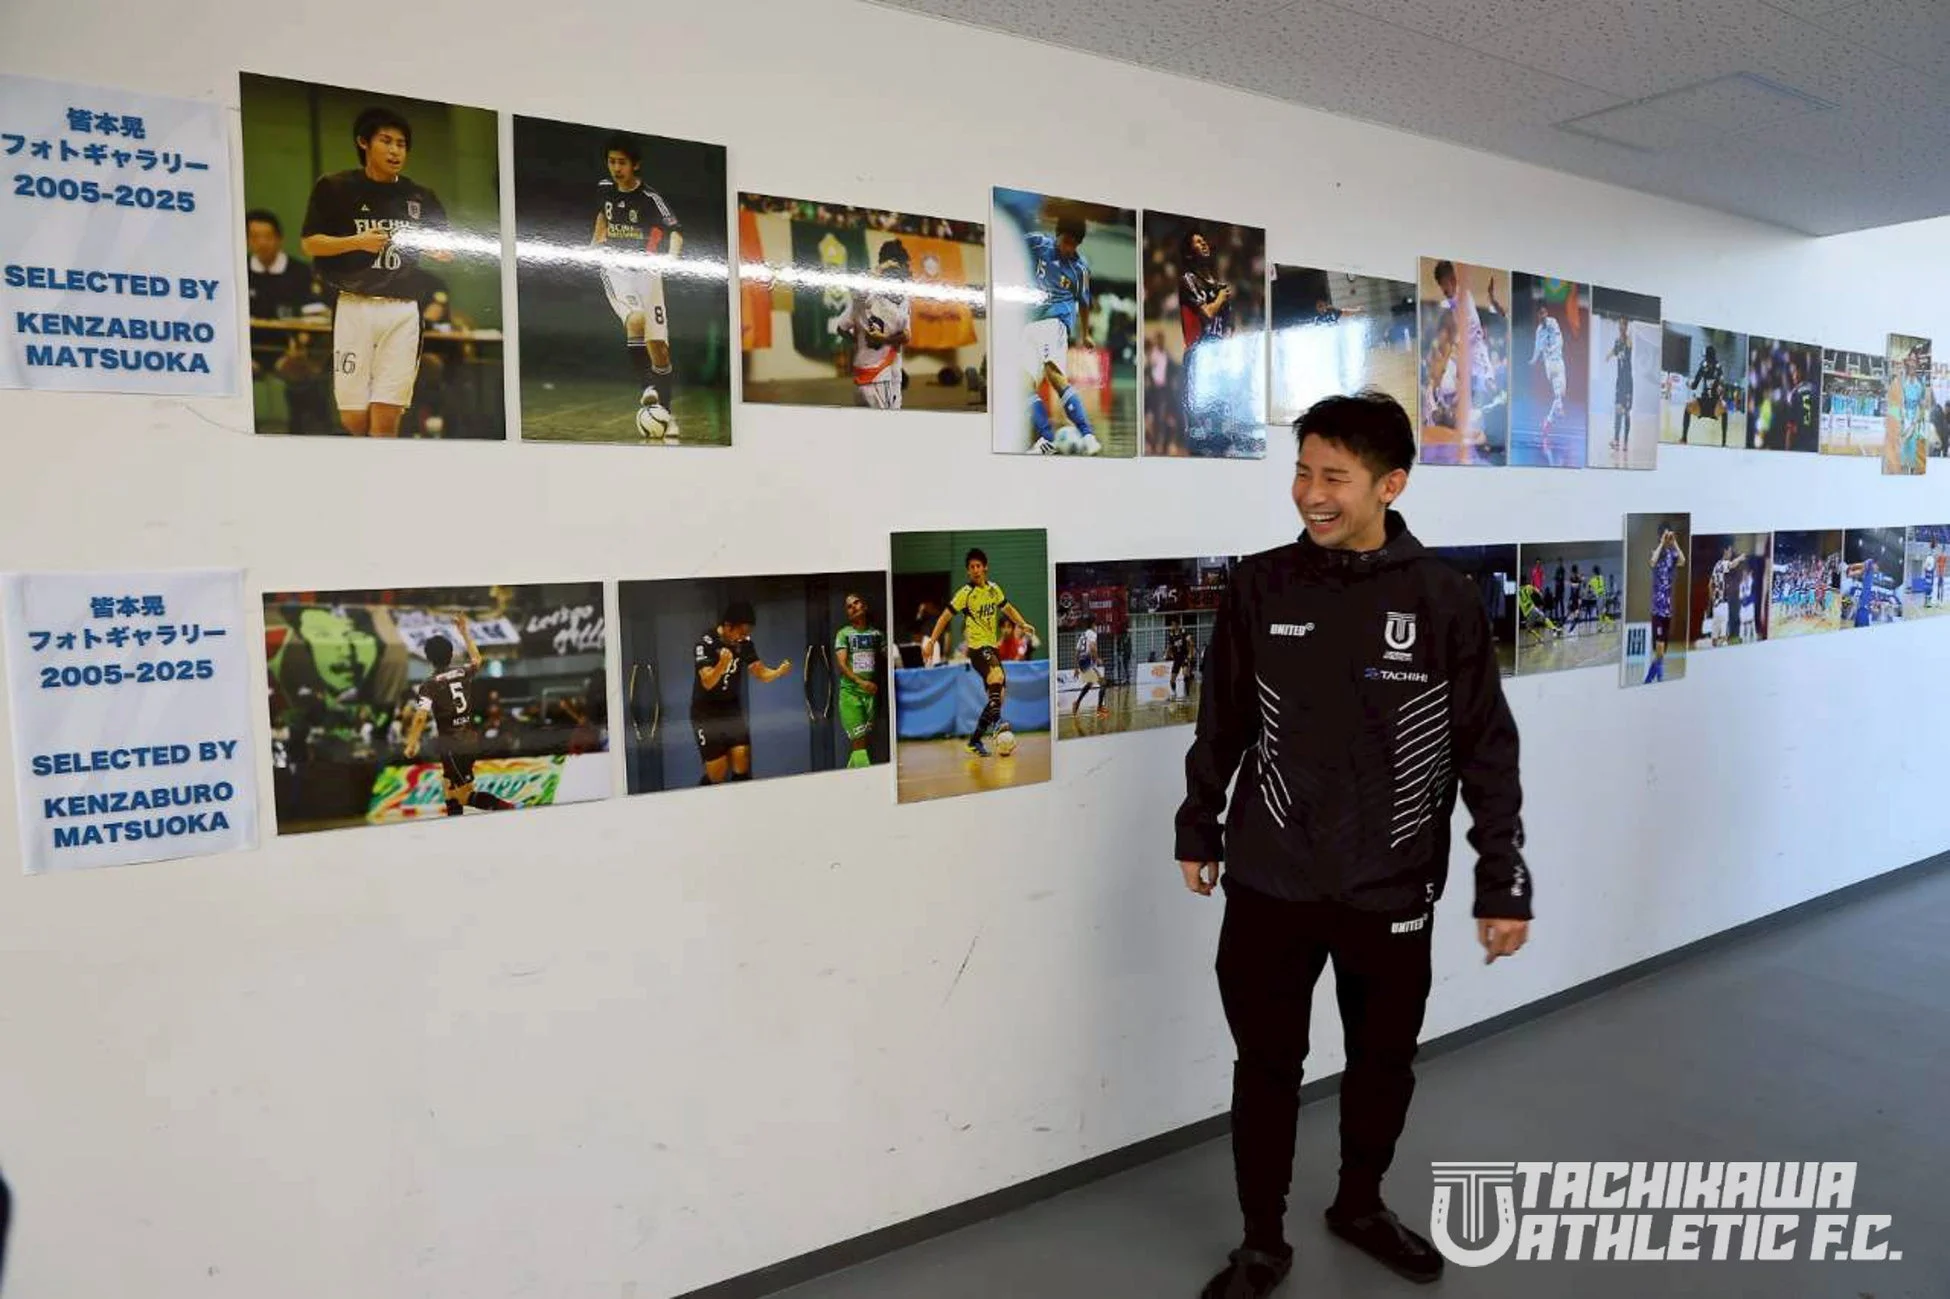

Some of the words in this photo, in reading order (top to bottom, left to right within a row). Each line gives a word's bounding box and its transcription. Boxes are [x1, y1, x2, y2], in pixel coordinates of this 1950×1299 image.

[67, 108, 146, 139] 皆本晃
[2, 133, 209, 174] フォトギャラリー
[14, 174, 195, 213] 2005-2025
[5, 265, 170, 298] SELECTED
[179, 279, 219, 301] BY
[16, 312, 214, 343] KENZABURO
[26, 345, 210, 373] MATSUOKA
[91, 595, 165, 618] 皆本晃
[28, 624, 226, 650] フォトギャラリー
[41, 660, 214, 688] 2005-2025
[449, 682, 467, 713] 5
[32, 744, 190, 776] SELECTED
[199, 740, 237, 761] BY
[44, 781, 234, 818] KENZABURO
[54, 811, 230, 848] MATSUOKA
[1425, 882, 1434, 902] 5
